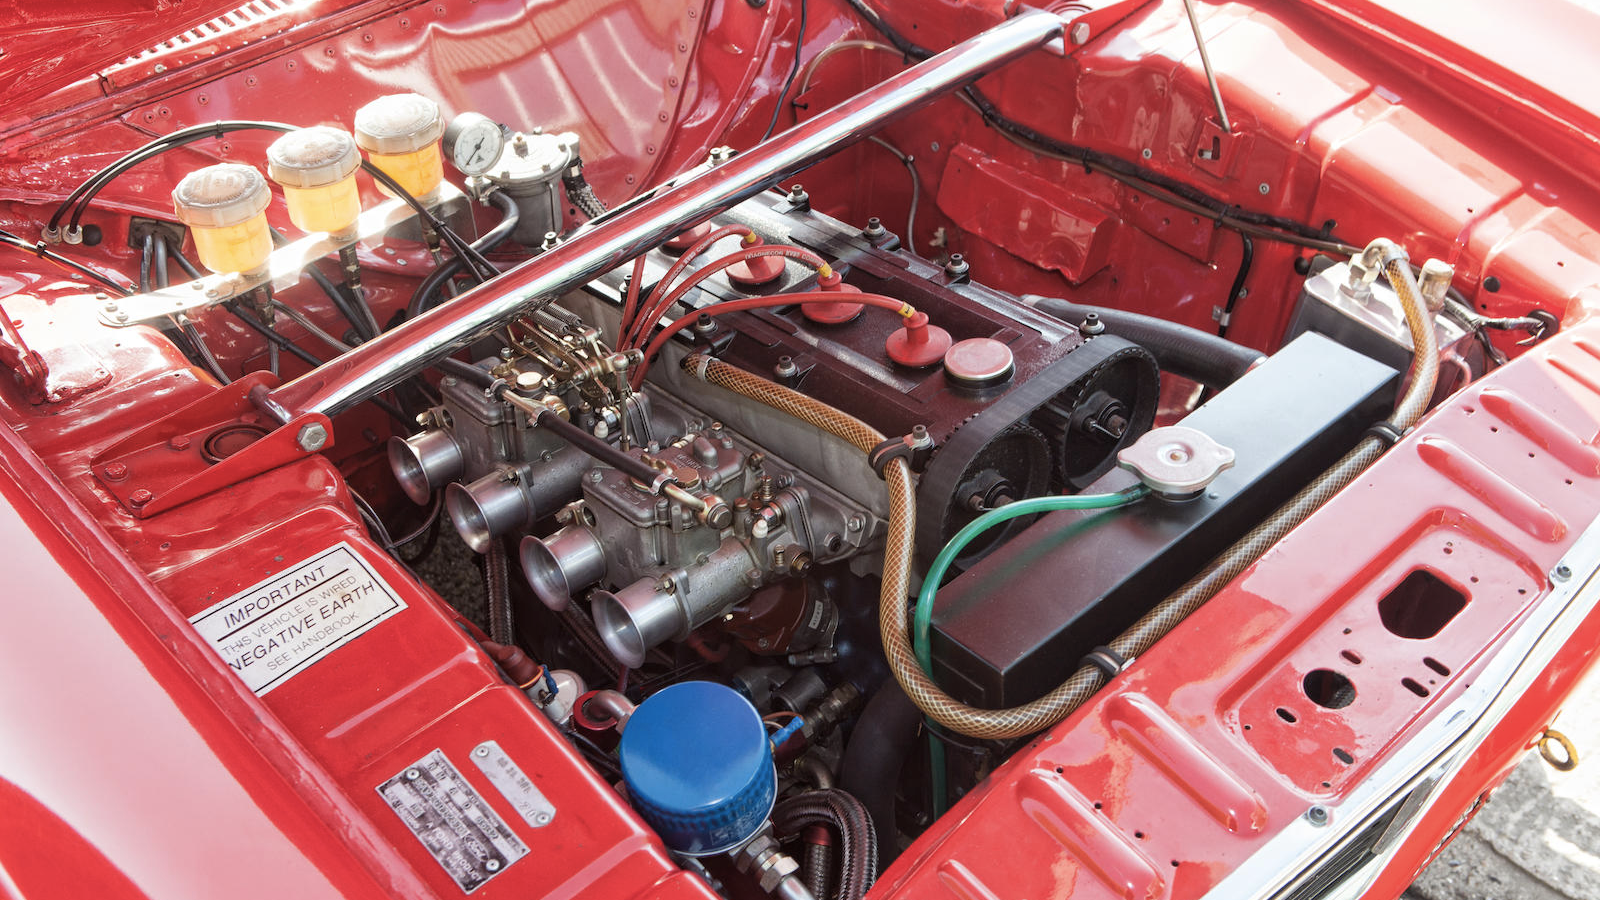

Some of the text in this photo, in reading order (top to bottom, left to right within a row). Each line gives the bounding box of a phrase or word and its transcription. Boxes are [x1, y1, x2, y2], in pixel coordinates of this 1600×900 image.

[222, 576, 357, 656] THIS VEHICLE IS WIRED
[224, 565, 326, 628] IMPORTANT
[320, 581, 376, 620] EARTH
[266, 611, 360, 671] SEE HANDBOOK
[431, 826, 454, 850] FORD
[453, 850, 482, 882] PRODUCT
